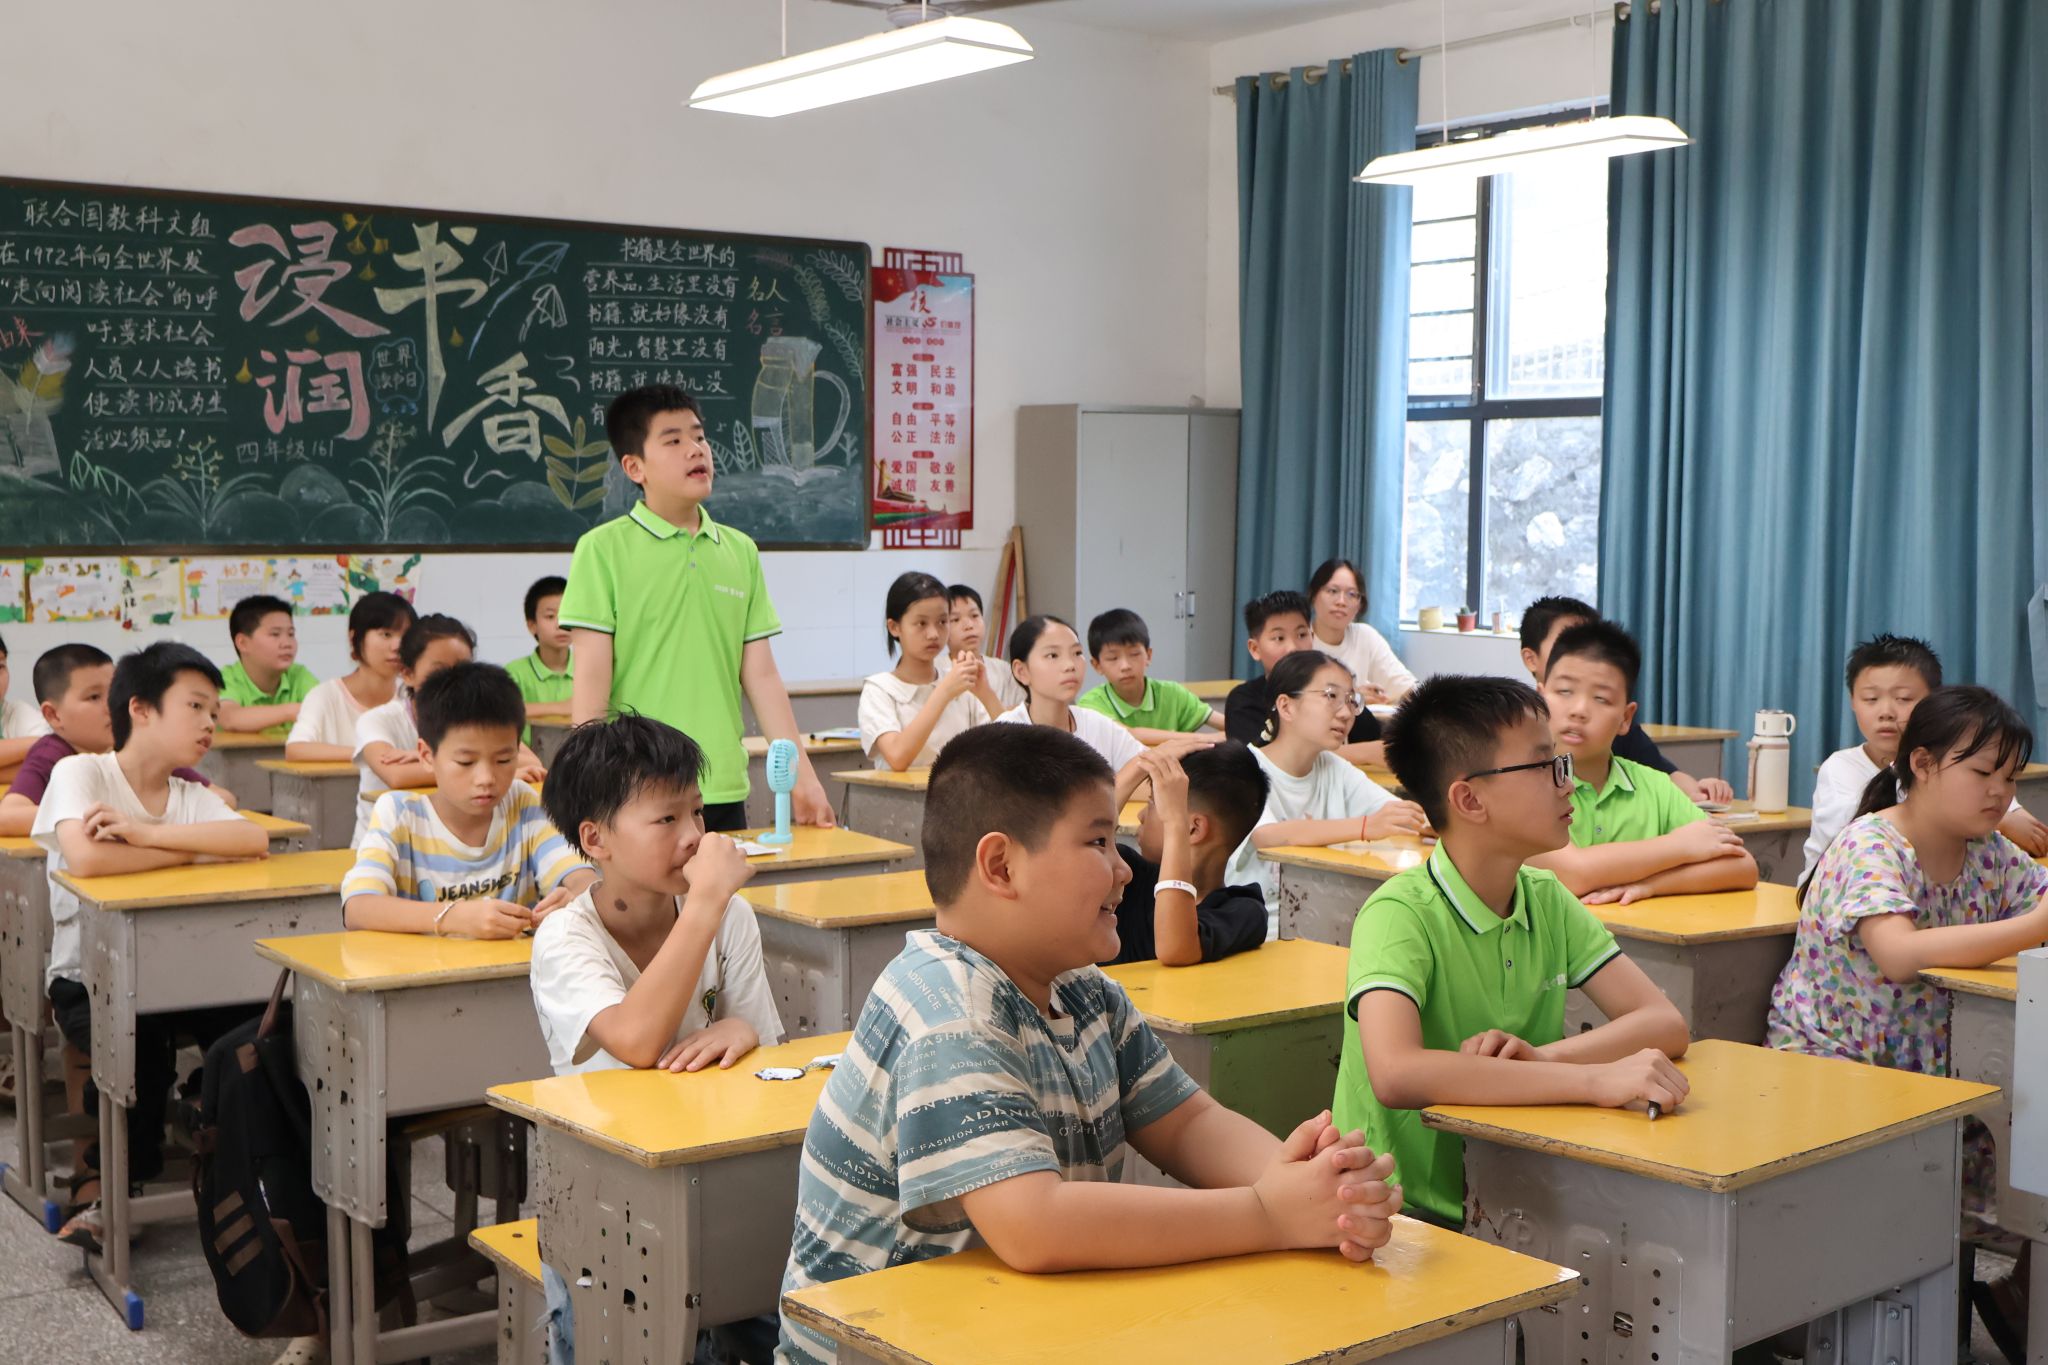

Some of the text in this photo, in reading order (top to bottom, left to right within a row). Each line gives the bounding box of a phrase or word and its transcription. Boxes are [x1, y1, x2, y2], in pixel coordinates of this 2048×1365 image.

[22, 198, 216, 239] 联合国教科文组
[620, 237, 735, 268] 书籍是全世界的
[747, 276, 789, 303] 名人
[891, 362, 956, 379] 富强 民主
[891, 381, 956, 397] 文明 和谐
[82, 390, 227, 418] 使读书成为生
[891, 412, 956, 428] 自由 平等
[891, 431, 956, 445] 公正 法治
[891, 460, 956, 476] 爱国 敬业
[891, 479, 956, 494] 诚信 友善
[960, 1105, 1040, 1126] ADDNIC
[919, 1128, 973, 1151] FASHION
[978, 1119, 1009, 1132] STAR
[816, 1150, 849, 1177] FASHION
[812, 1199, 861, 1232] ADDNICE
